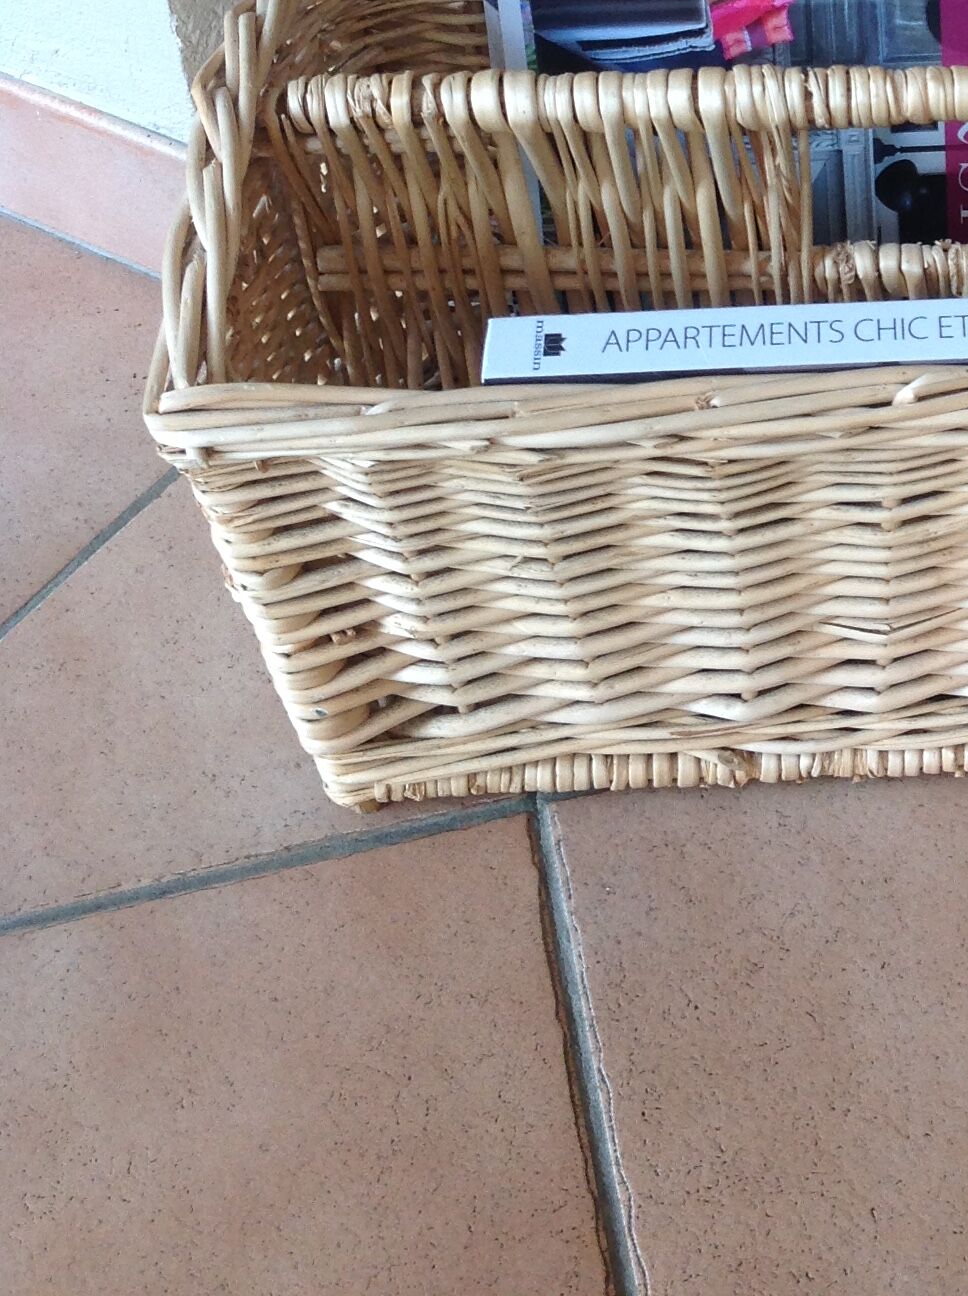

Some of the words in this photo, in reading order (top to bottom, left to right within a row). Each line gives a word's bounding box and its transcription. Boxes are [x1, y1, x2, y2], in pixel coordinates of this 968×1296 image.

[532, 320, 544, 371] massin
[601, 317, 845, 353] APPARTEMENTS
[853, 315, 928, 343] CHIC
